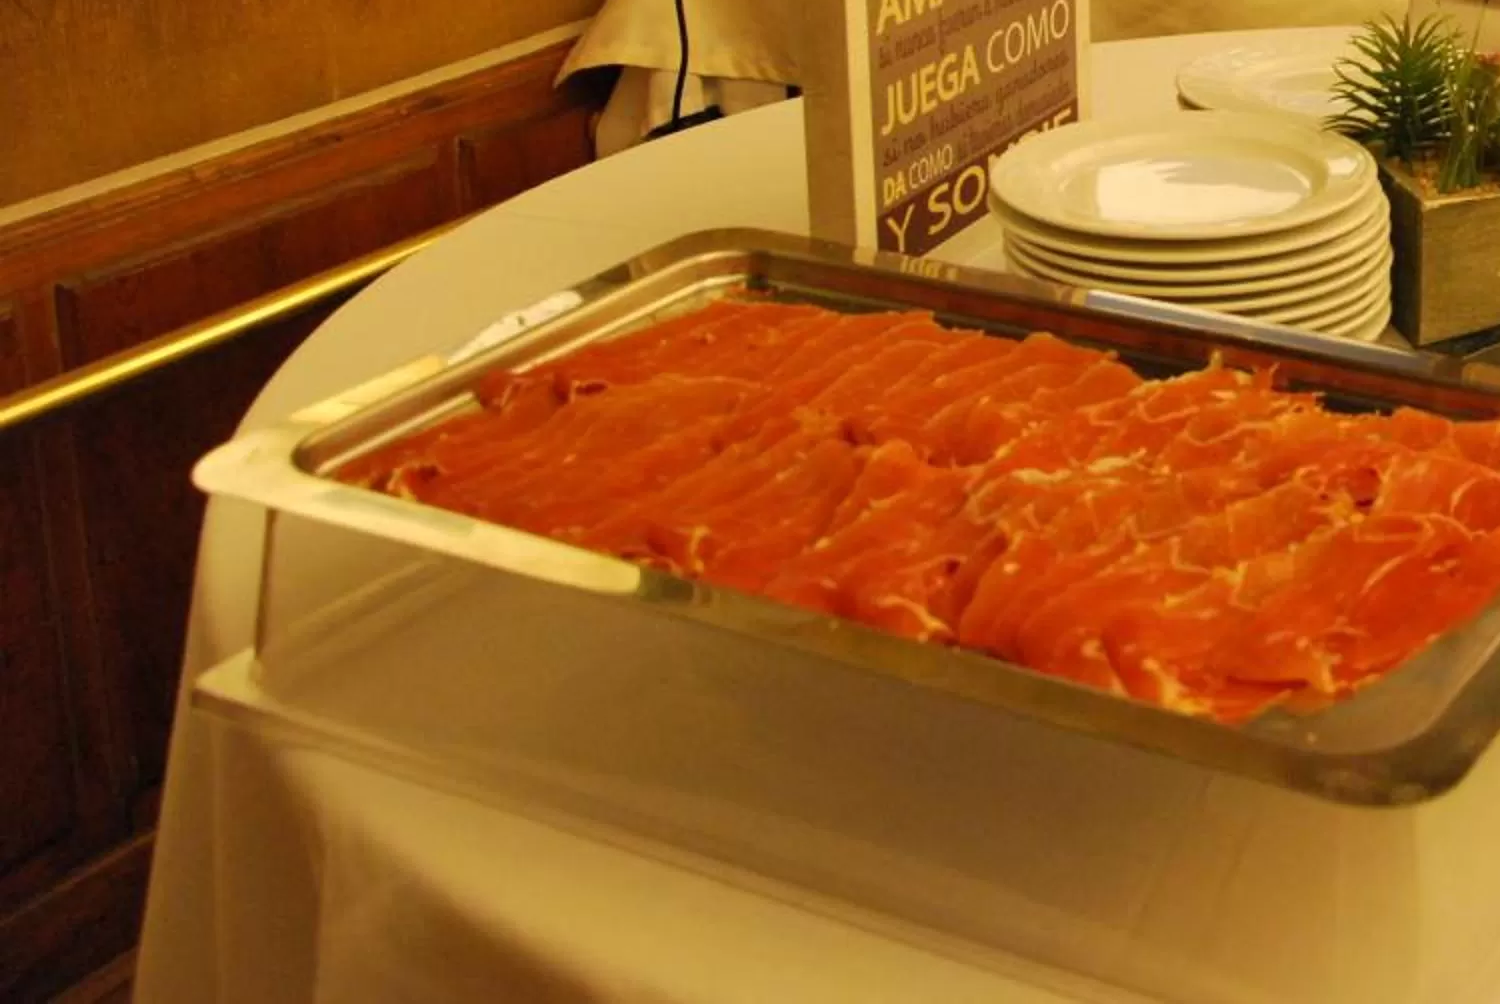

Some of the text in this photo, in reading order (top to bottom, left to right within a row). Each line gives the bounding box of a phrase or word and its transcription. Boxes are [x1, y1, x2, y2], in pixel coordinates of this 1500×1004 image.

[881, 44, 981, 136] JUEGA
[883, 144, 953, 208] DA COMO
[886, 203, 915, 253] Y
